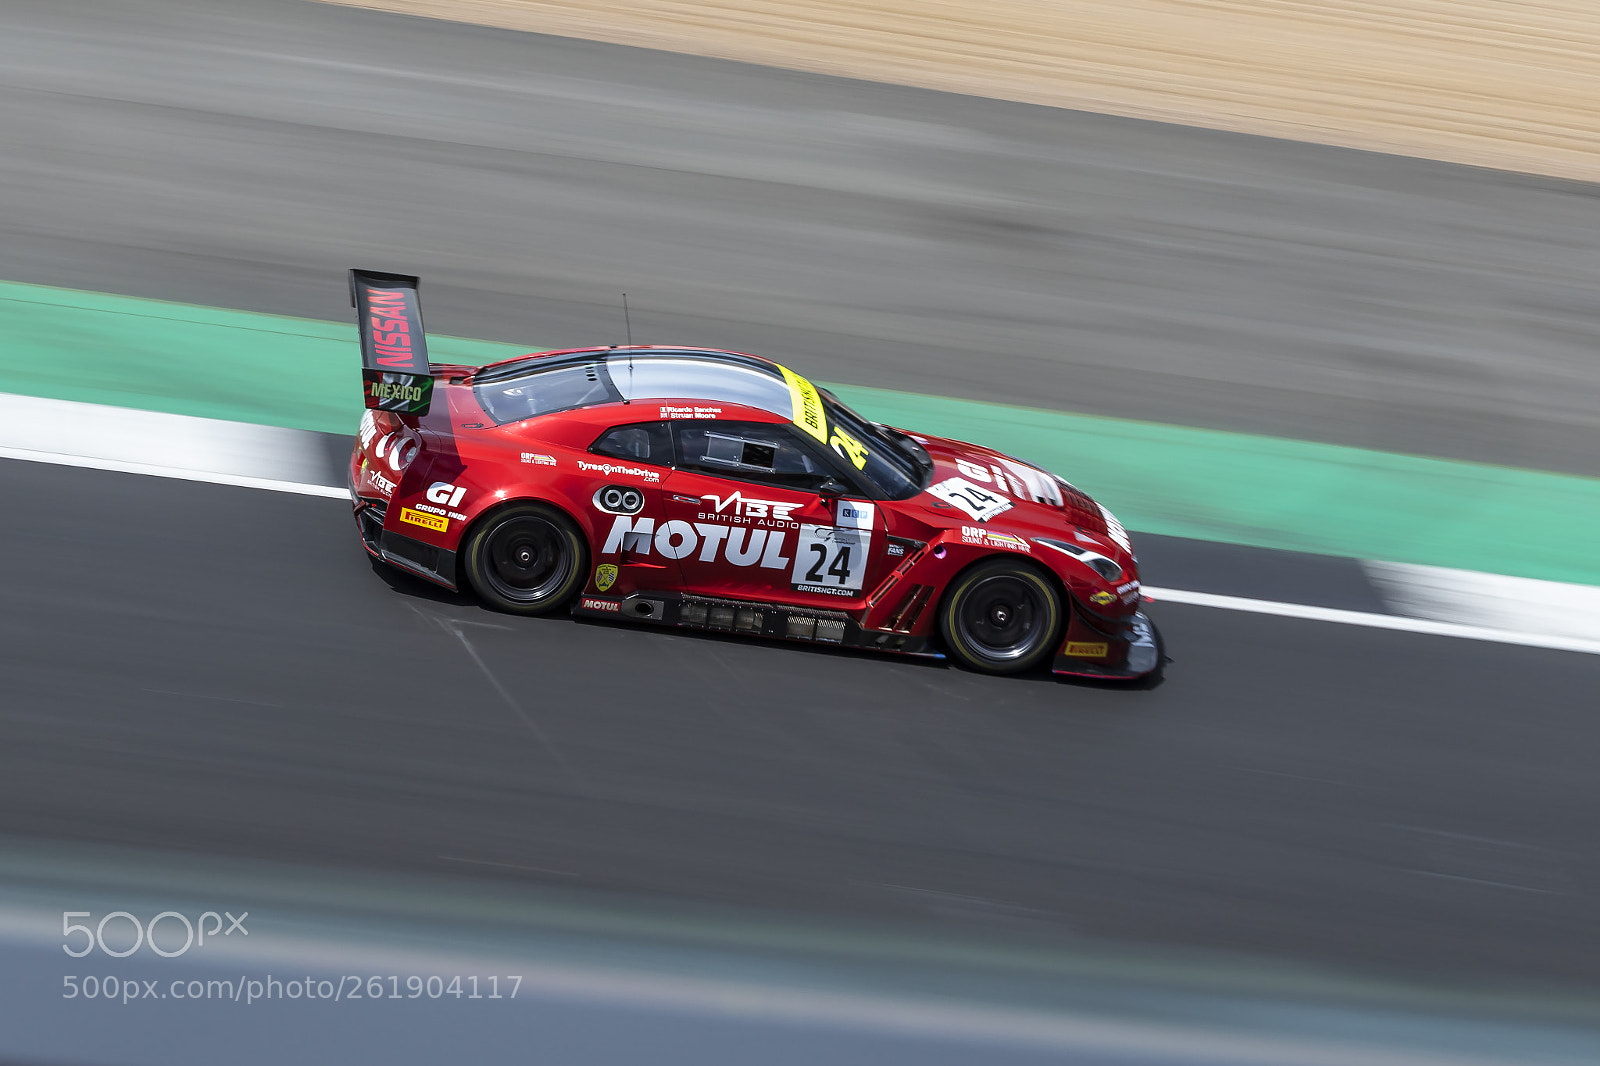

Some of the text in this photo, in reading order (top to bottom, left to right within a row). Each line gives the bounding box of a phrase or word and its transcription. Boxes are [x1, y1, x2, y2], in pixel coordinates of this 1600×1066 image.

[367, 289, 414, 368] NISSAN
[371, 382, 421, 401] MEXICO
[830, 426, 869, 471] 24
[426, 481, 467, 508] GI
[948, 487, 999, 512] 24
[405, 511, 444, 529] PIRELLI
[415, 503, 468, 522] GRUPO INDI
[698, 512, 799, 529] BRITISH AUDIO
[961, 525, 987, 539] ORP
[601, 515, 790, 570] MOTUL
[805, 543, 851, 585] 24
[797, 585, 854, 597] BRITISHGT.COM
[583, 599, 619, 612] MOTUL
